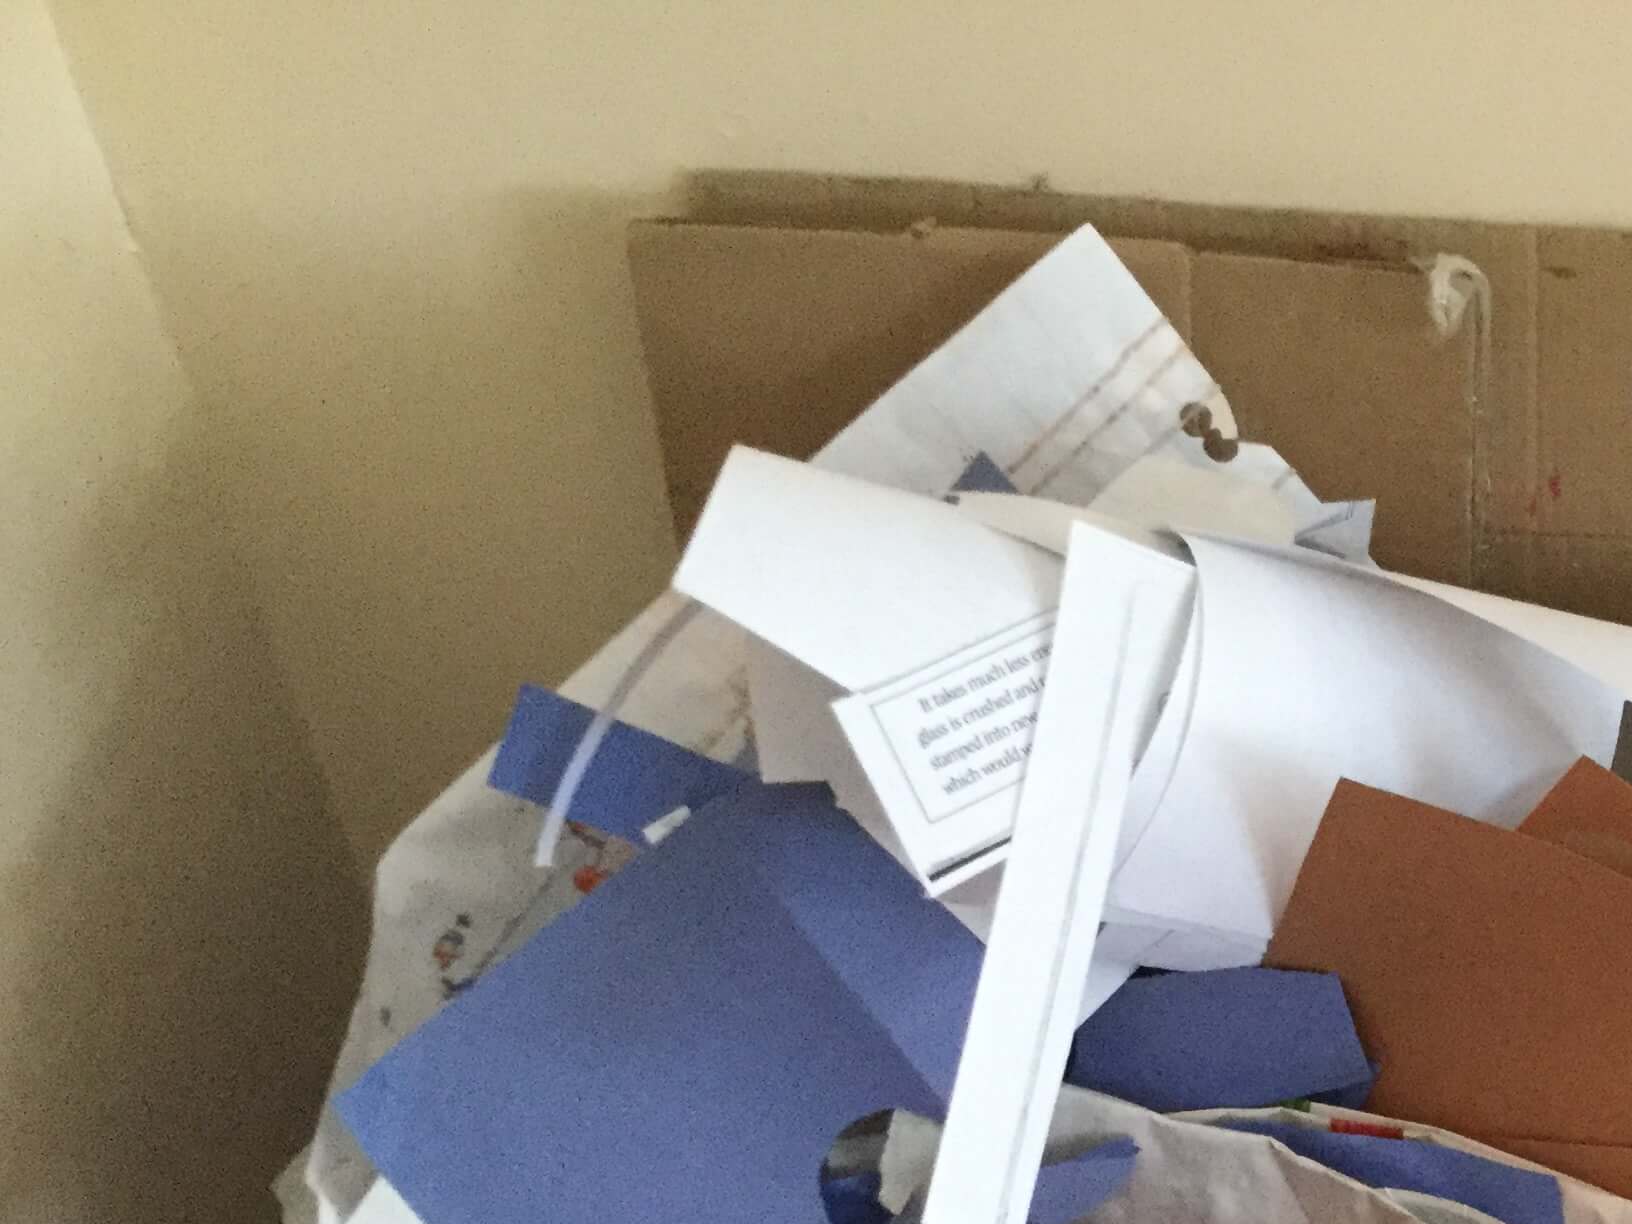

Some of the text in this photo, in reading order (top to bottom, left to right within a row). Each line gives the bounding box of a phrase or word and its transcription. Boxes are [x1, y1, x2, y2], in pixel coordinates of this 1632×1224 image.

[932, 685, 968, 707] takes
[967, 664, 1006, 691] much
[1003, 656, 1031, 673] less
[918, 724, 949, 749] glass
[948, 716, 963, 731] is
[962, 690, 1014, 724] crushed
[1013, 677, 1039, 700] and
[930, 735, 984, 770] stamped
[982, 726, 1011, 745] into
[943, 768, 982, 794] which
[981, 746, 1022, 775] would
